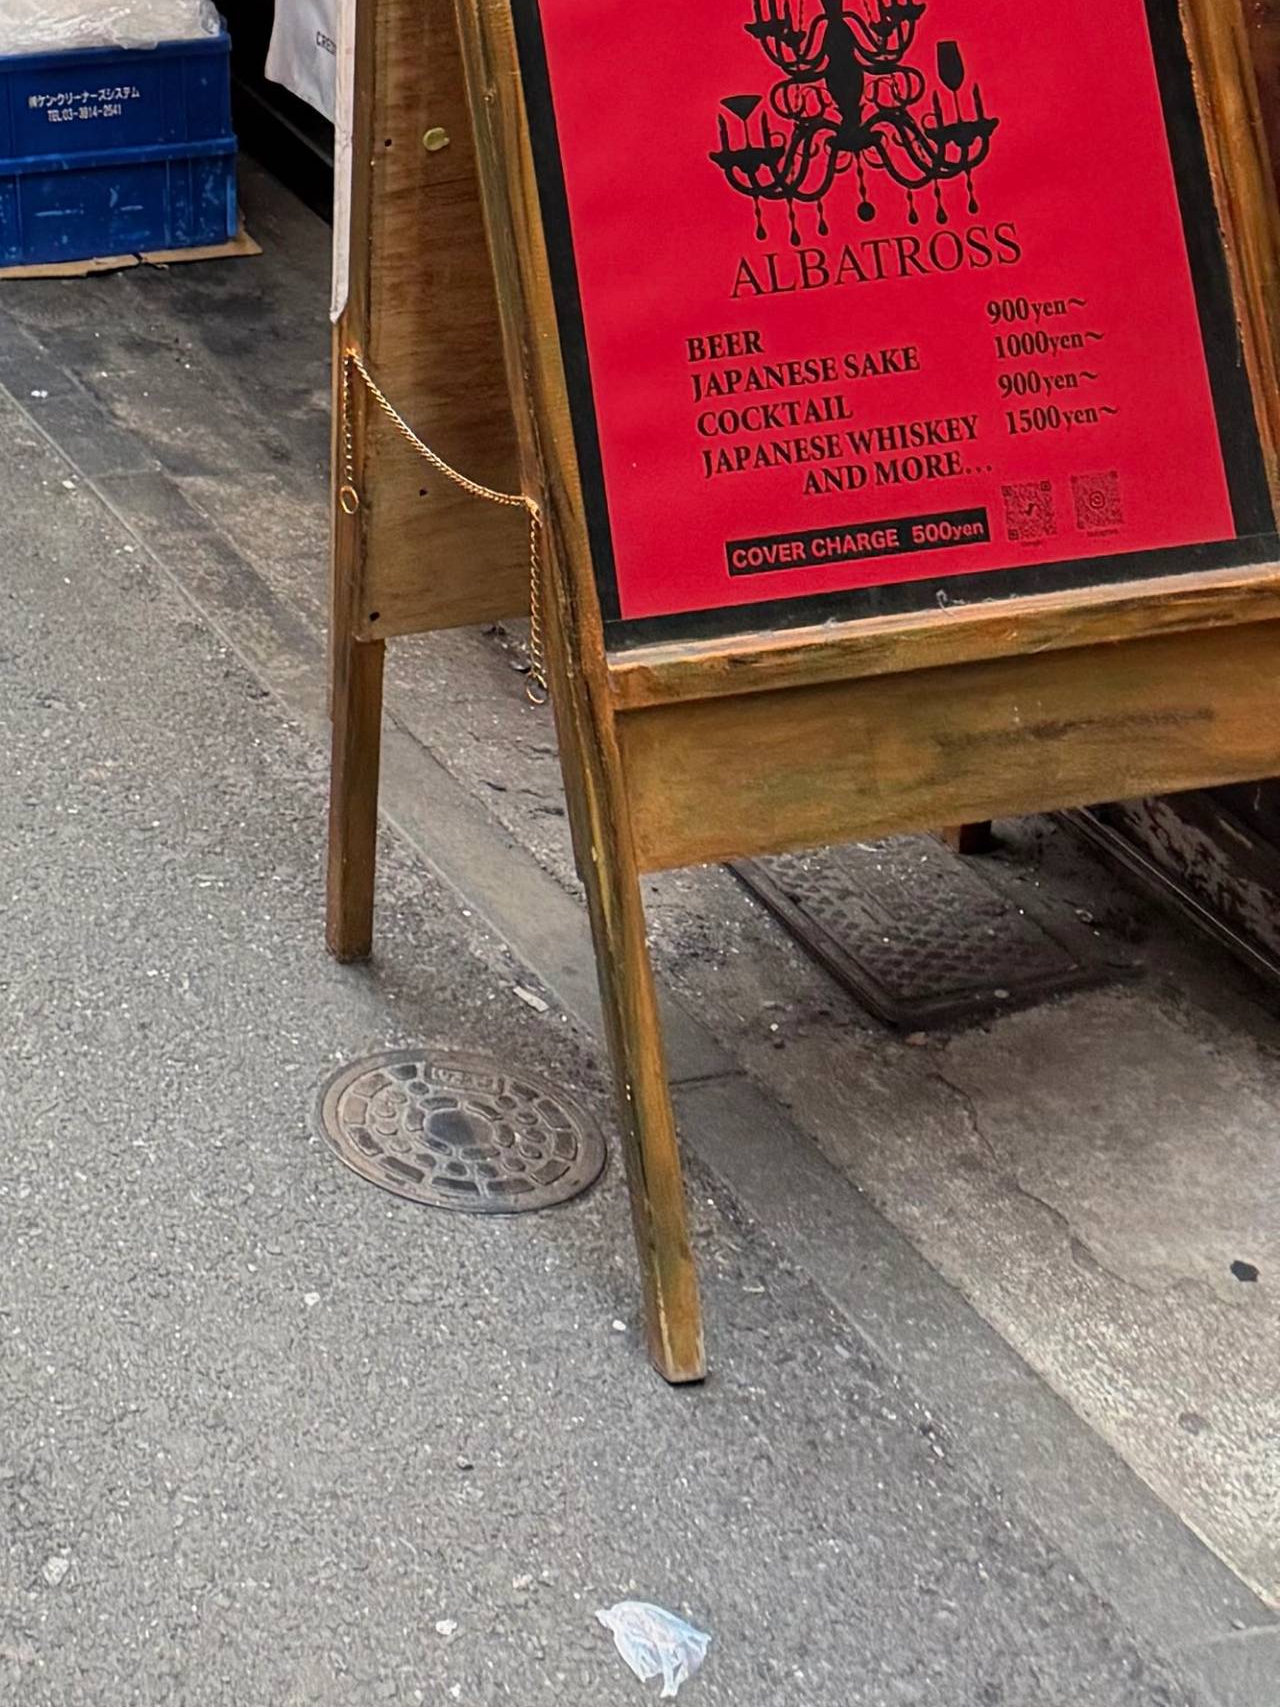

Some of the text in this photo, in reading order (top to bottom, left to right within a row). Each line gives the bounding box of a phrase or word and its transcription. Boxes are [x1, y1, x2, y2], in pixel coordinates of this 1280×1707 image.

[728, 223, 1023, 302] ALBATROSS
[685, 329, 765, 364] BEER
[690, 344, 922, 404] JAPANESE SAKE
[696, 394, 854, 438] COCKTAIL
[702, 413, 980, 479] JAPANESE WHISKEY
[801, 463, 868, 496] AND
[731, 540, 806, 569] COVER
[810, 528, 900, 558] CHARGE
[911, 520, 985, 545] 500yen
